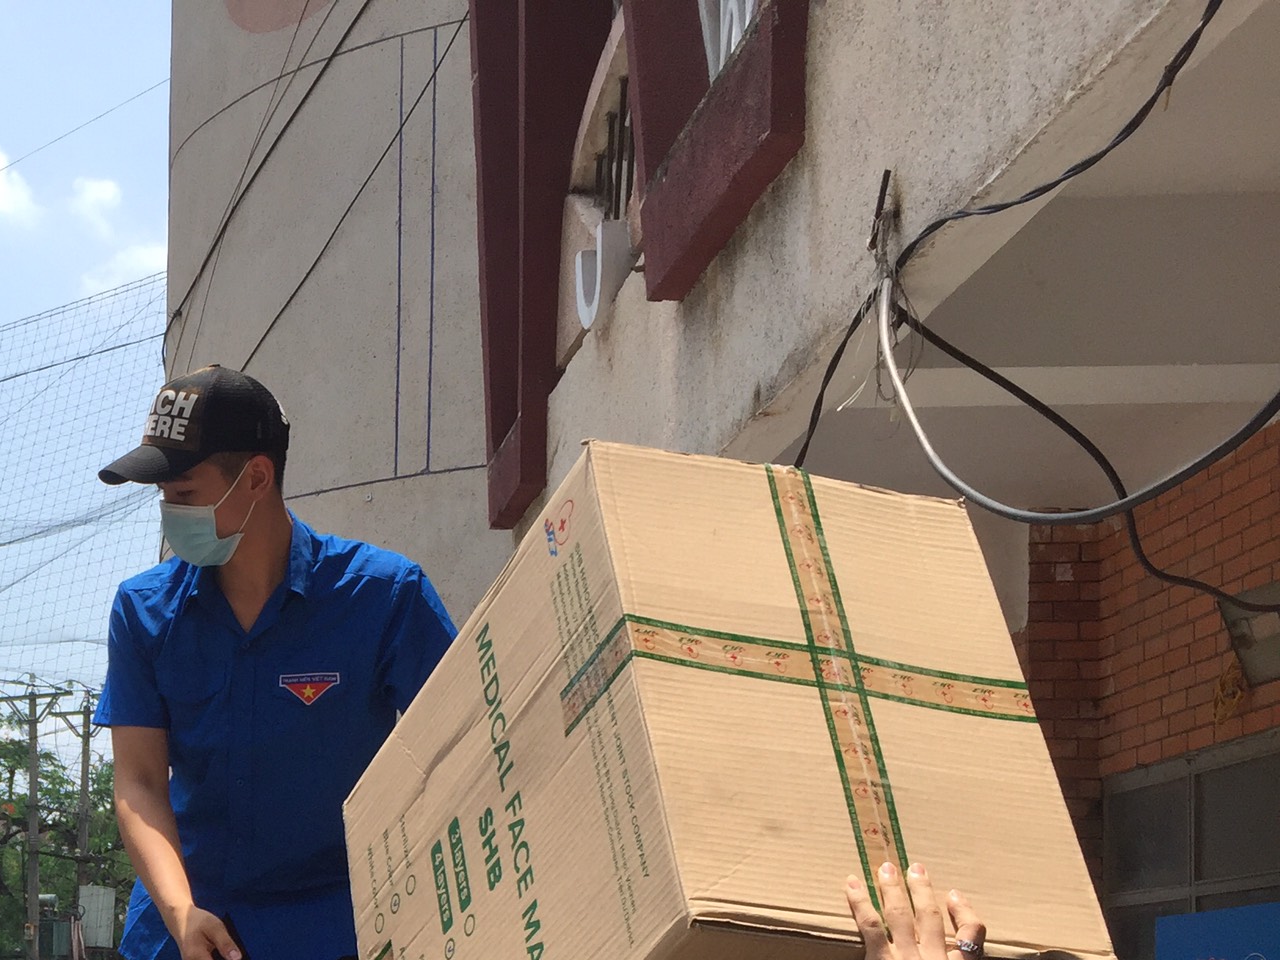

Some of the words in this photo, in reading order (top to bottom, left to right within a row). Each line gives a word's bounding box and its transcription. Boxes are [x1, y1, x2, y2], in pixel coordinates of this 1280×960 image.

[144, 414, 189, 441] ERE
[151, 389, 199, 418] CH
[474, 618, 516, 796] MEDICAL
[503, 788, 535, 901] FACE
[450, 824, 460, 847] 3
[613, 726, 626, 768] JOINT
[621, 765, 636, 814] STOCK
[630, 811, 650, 882] COMPANY
[433, 846, 443, 868] 4
[451, 837, 470, 905] layers
[477, 801, 503, 895] SHB
[434, 860, 452, 926] layers
